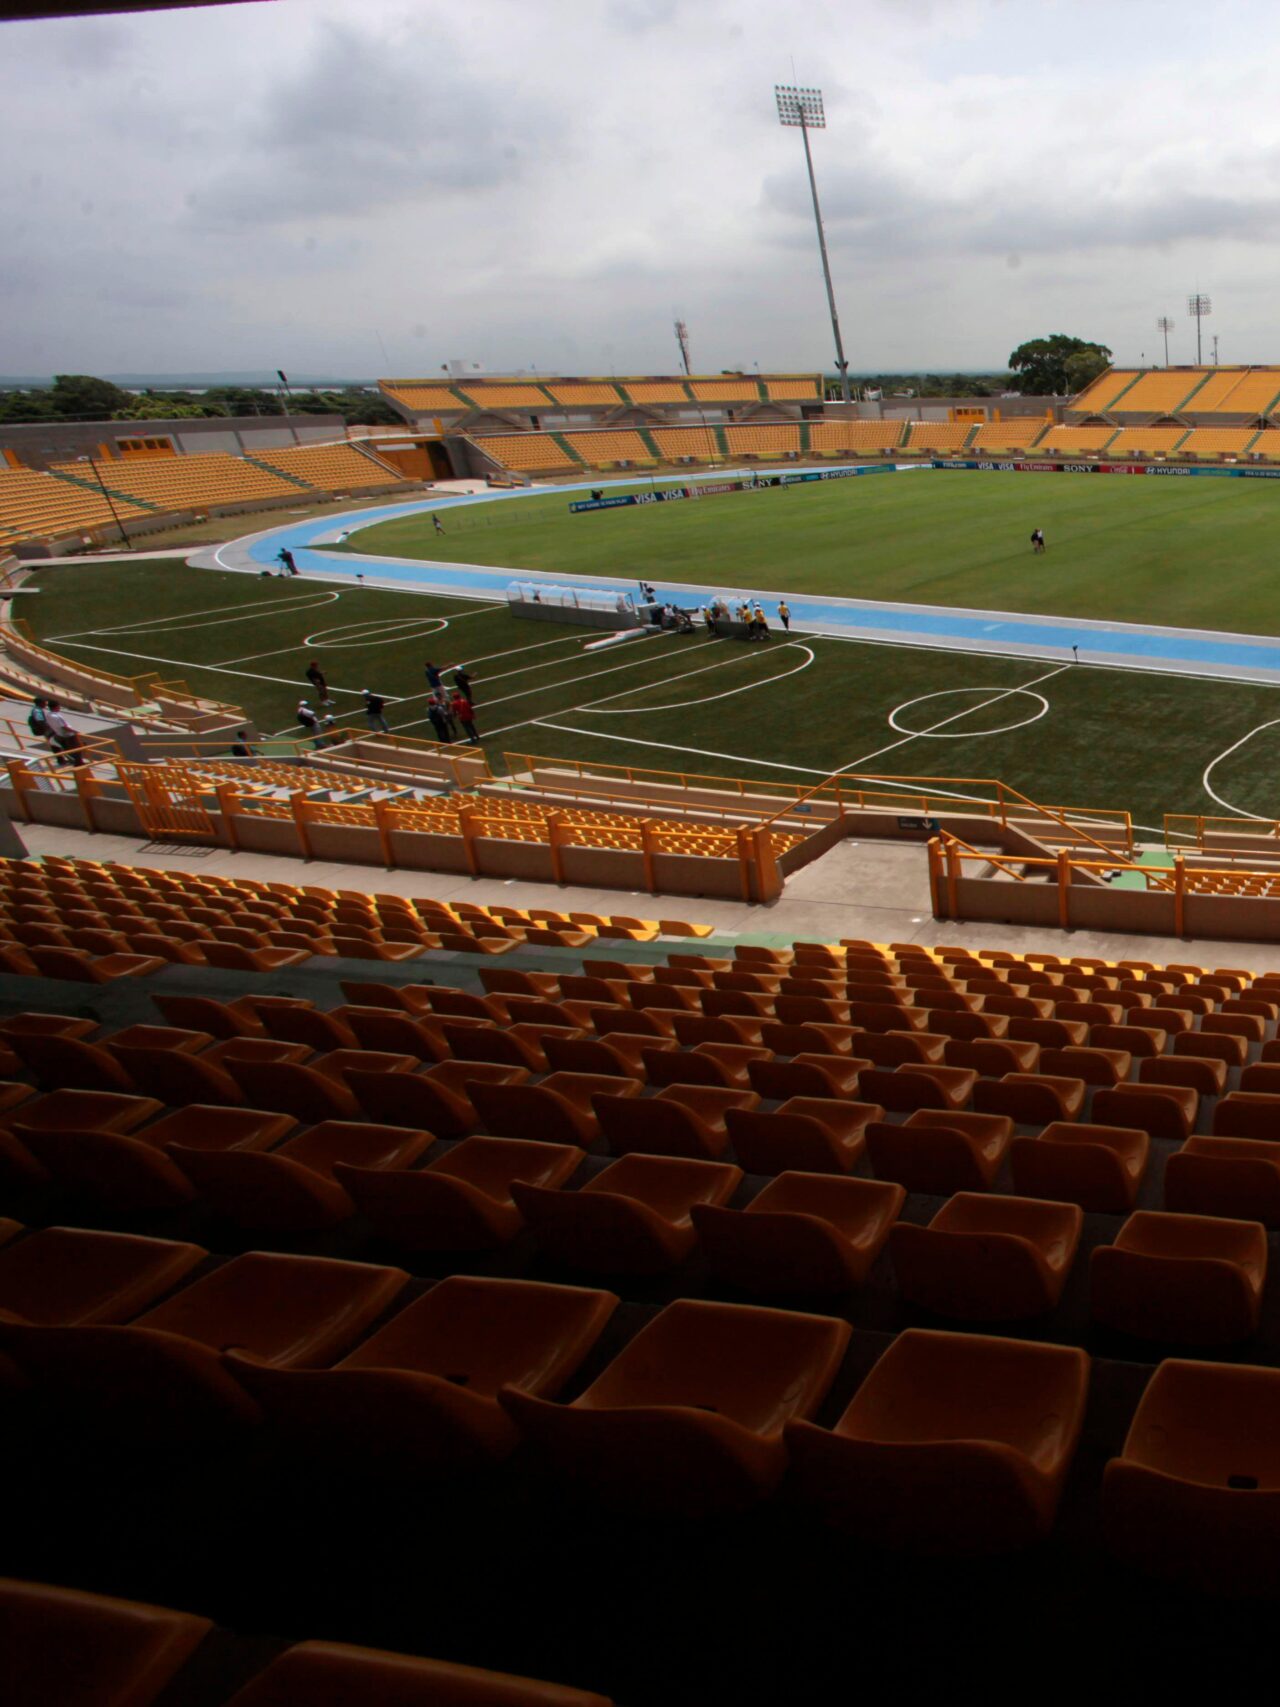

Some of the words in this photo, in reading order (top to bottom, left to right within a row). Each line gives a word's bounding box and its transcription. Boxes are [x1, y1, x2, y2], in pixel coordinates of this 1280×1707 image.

[998, 463, 1014, 471] VISA
[831, 469, 858, 478] HYUNDAI
[634, 493, 657, 504] VISA
[662, 489, 684, 501] VISA
